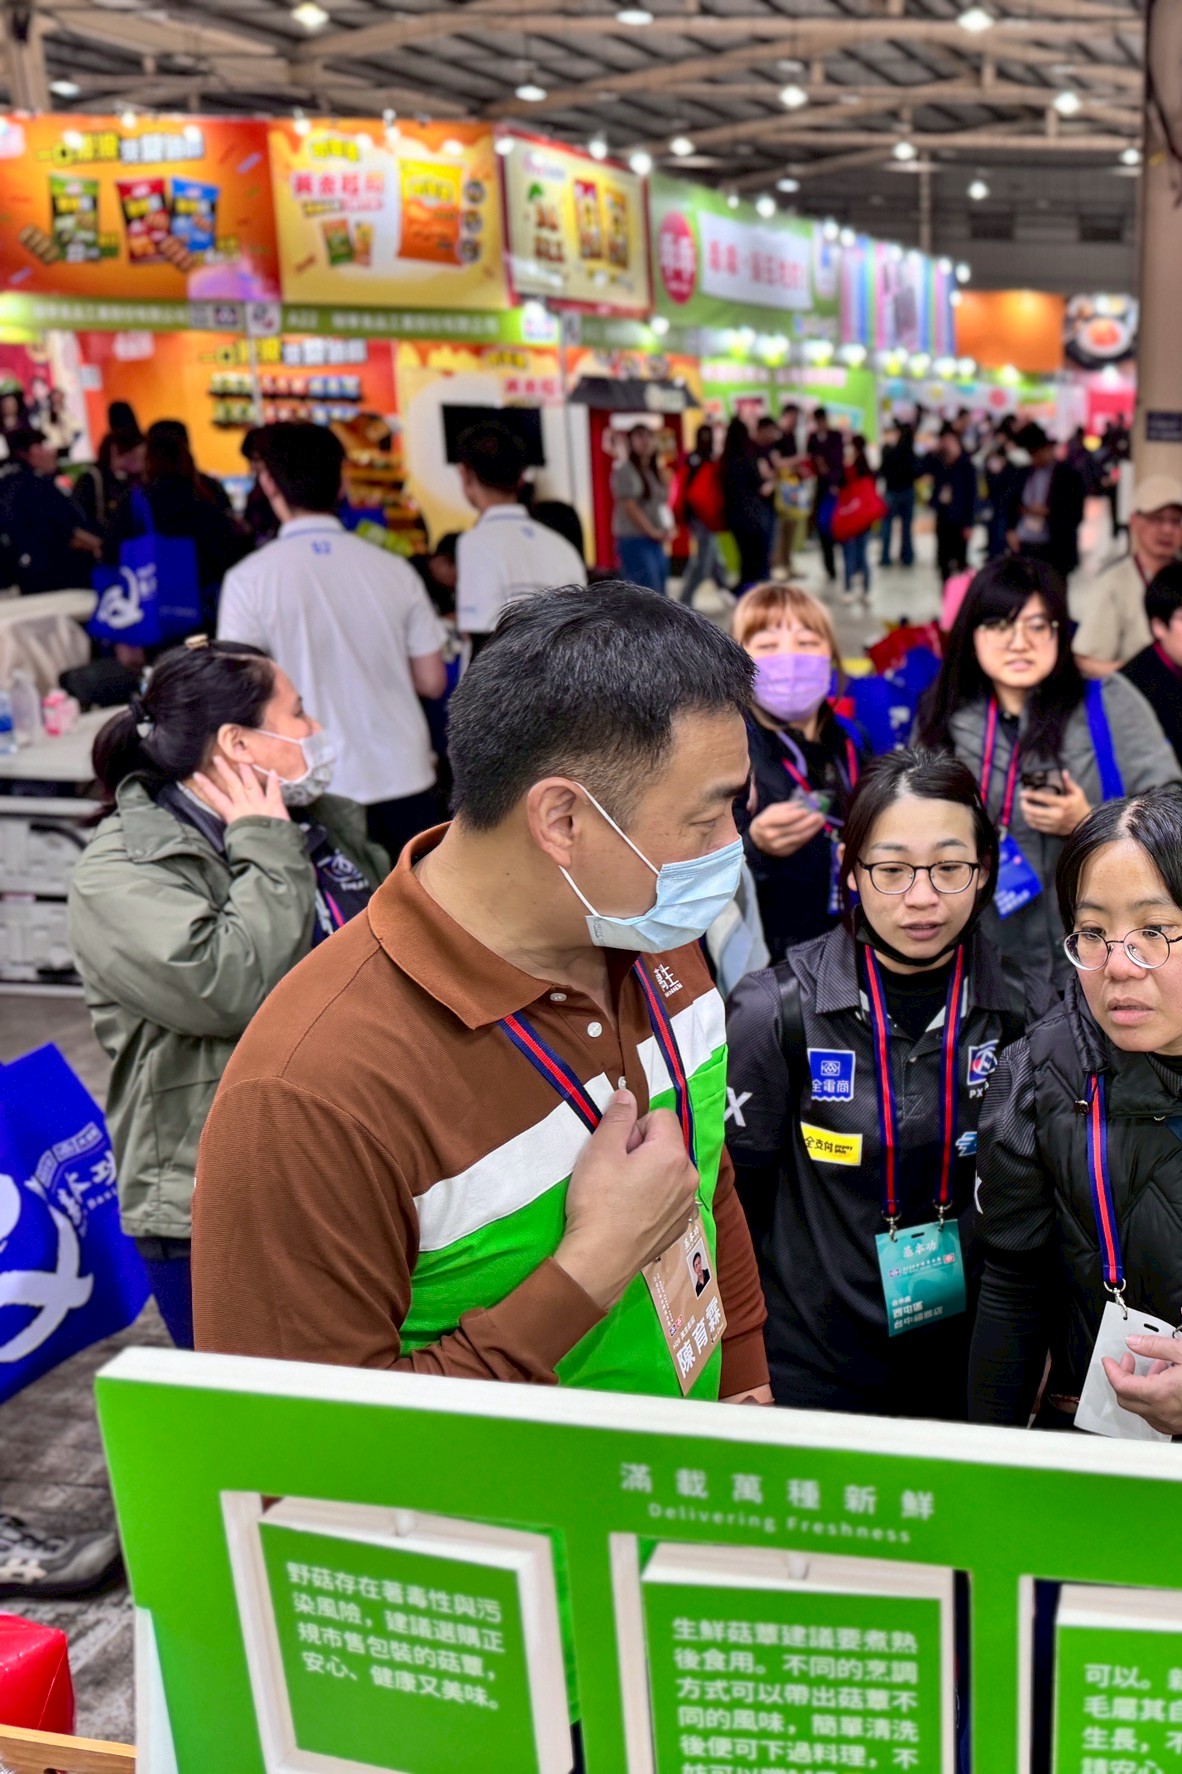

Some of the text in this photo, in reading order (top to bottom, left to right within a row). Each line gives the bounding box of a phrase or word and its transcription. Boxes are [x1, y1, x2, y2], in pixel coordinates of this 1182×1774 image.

[812, 1079, 850, 1094] 全電商
[806, 1136, 833, 1153] 全支付
[676, 1296, 721, 1378] 陳育霖
[620, 1462, 935, 1520] 滿載萬種新鮮
[649, 1503, 911, 1544] Delivering Freshness
[287, 1562, 502, 1623] 野菇存在著毒性與污
[293, 1592, 506, 1653] 染風險，建議選購正
[672, 1617, 918, 1654] 生鮮菇蕈建議要煮熟
[298, 1622, 496, 1681] 規市售包裝的菇蕈，
[674, 1648, 918, 1684] 後食用。不同的烹調
[303, 1652, 499, 1710] 安心、健康又美味。
[675, 1677, 919, 1713] 方式可以帶出菇蕈不
[677, 1706, 920, 1742] 同的風味，簡單清洗
[680, 1735, 919, 1770] 後便可下過料理，不
